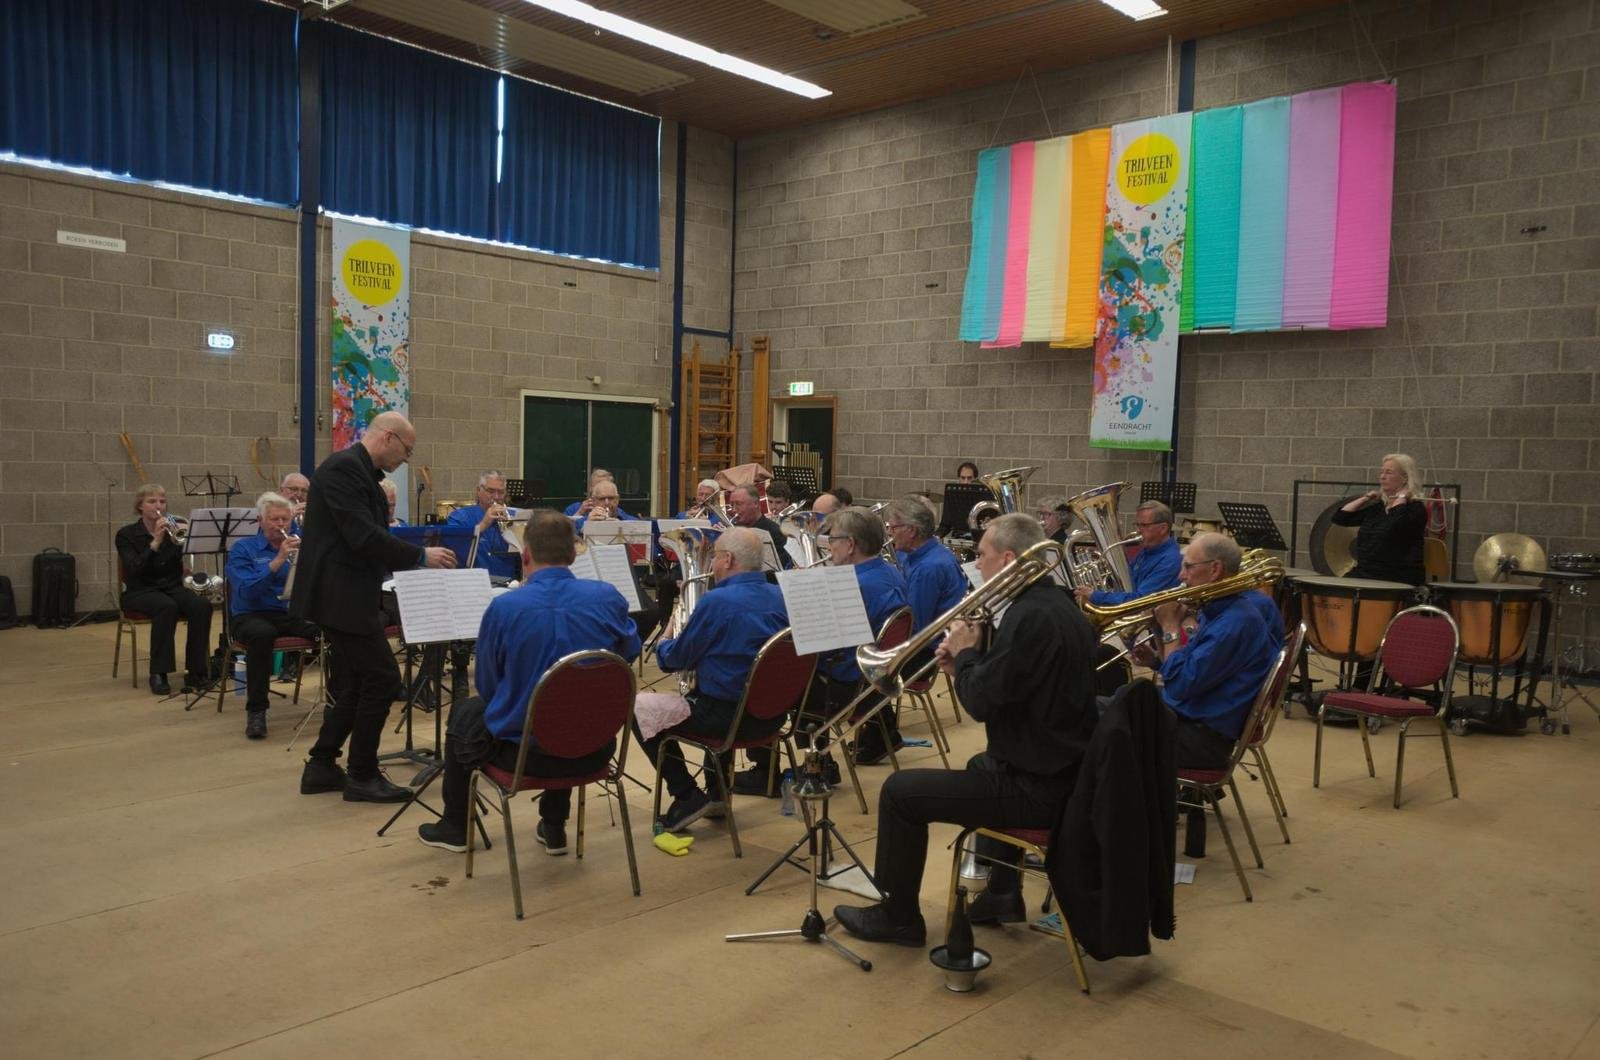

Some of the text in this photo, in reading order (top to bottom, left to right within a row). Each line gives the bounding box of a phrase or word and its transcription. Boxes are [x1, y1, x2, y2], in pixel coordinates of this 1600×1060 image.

[1124, 153, 1173, 173] TRILVEEN
[1127, 171, 1168, 188] FESTIVAL
[348, 258, 395, 277] TRILVEEN
[352, 274, 391, 289] FESTIVAL
[1109, 422, 1152, 430] EENDRACHT
